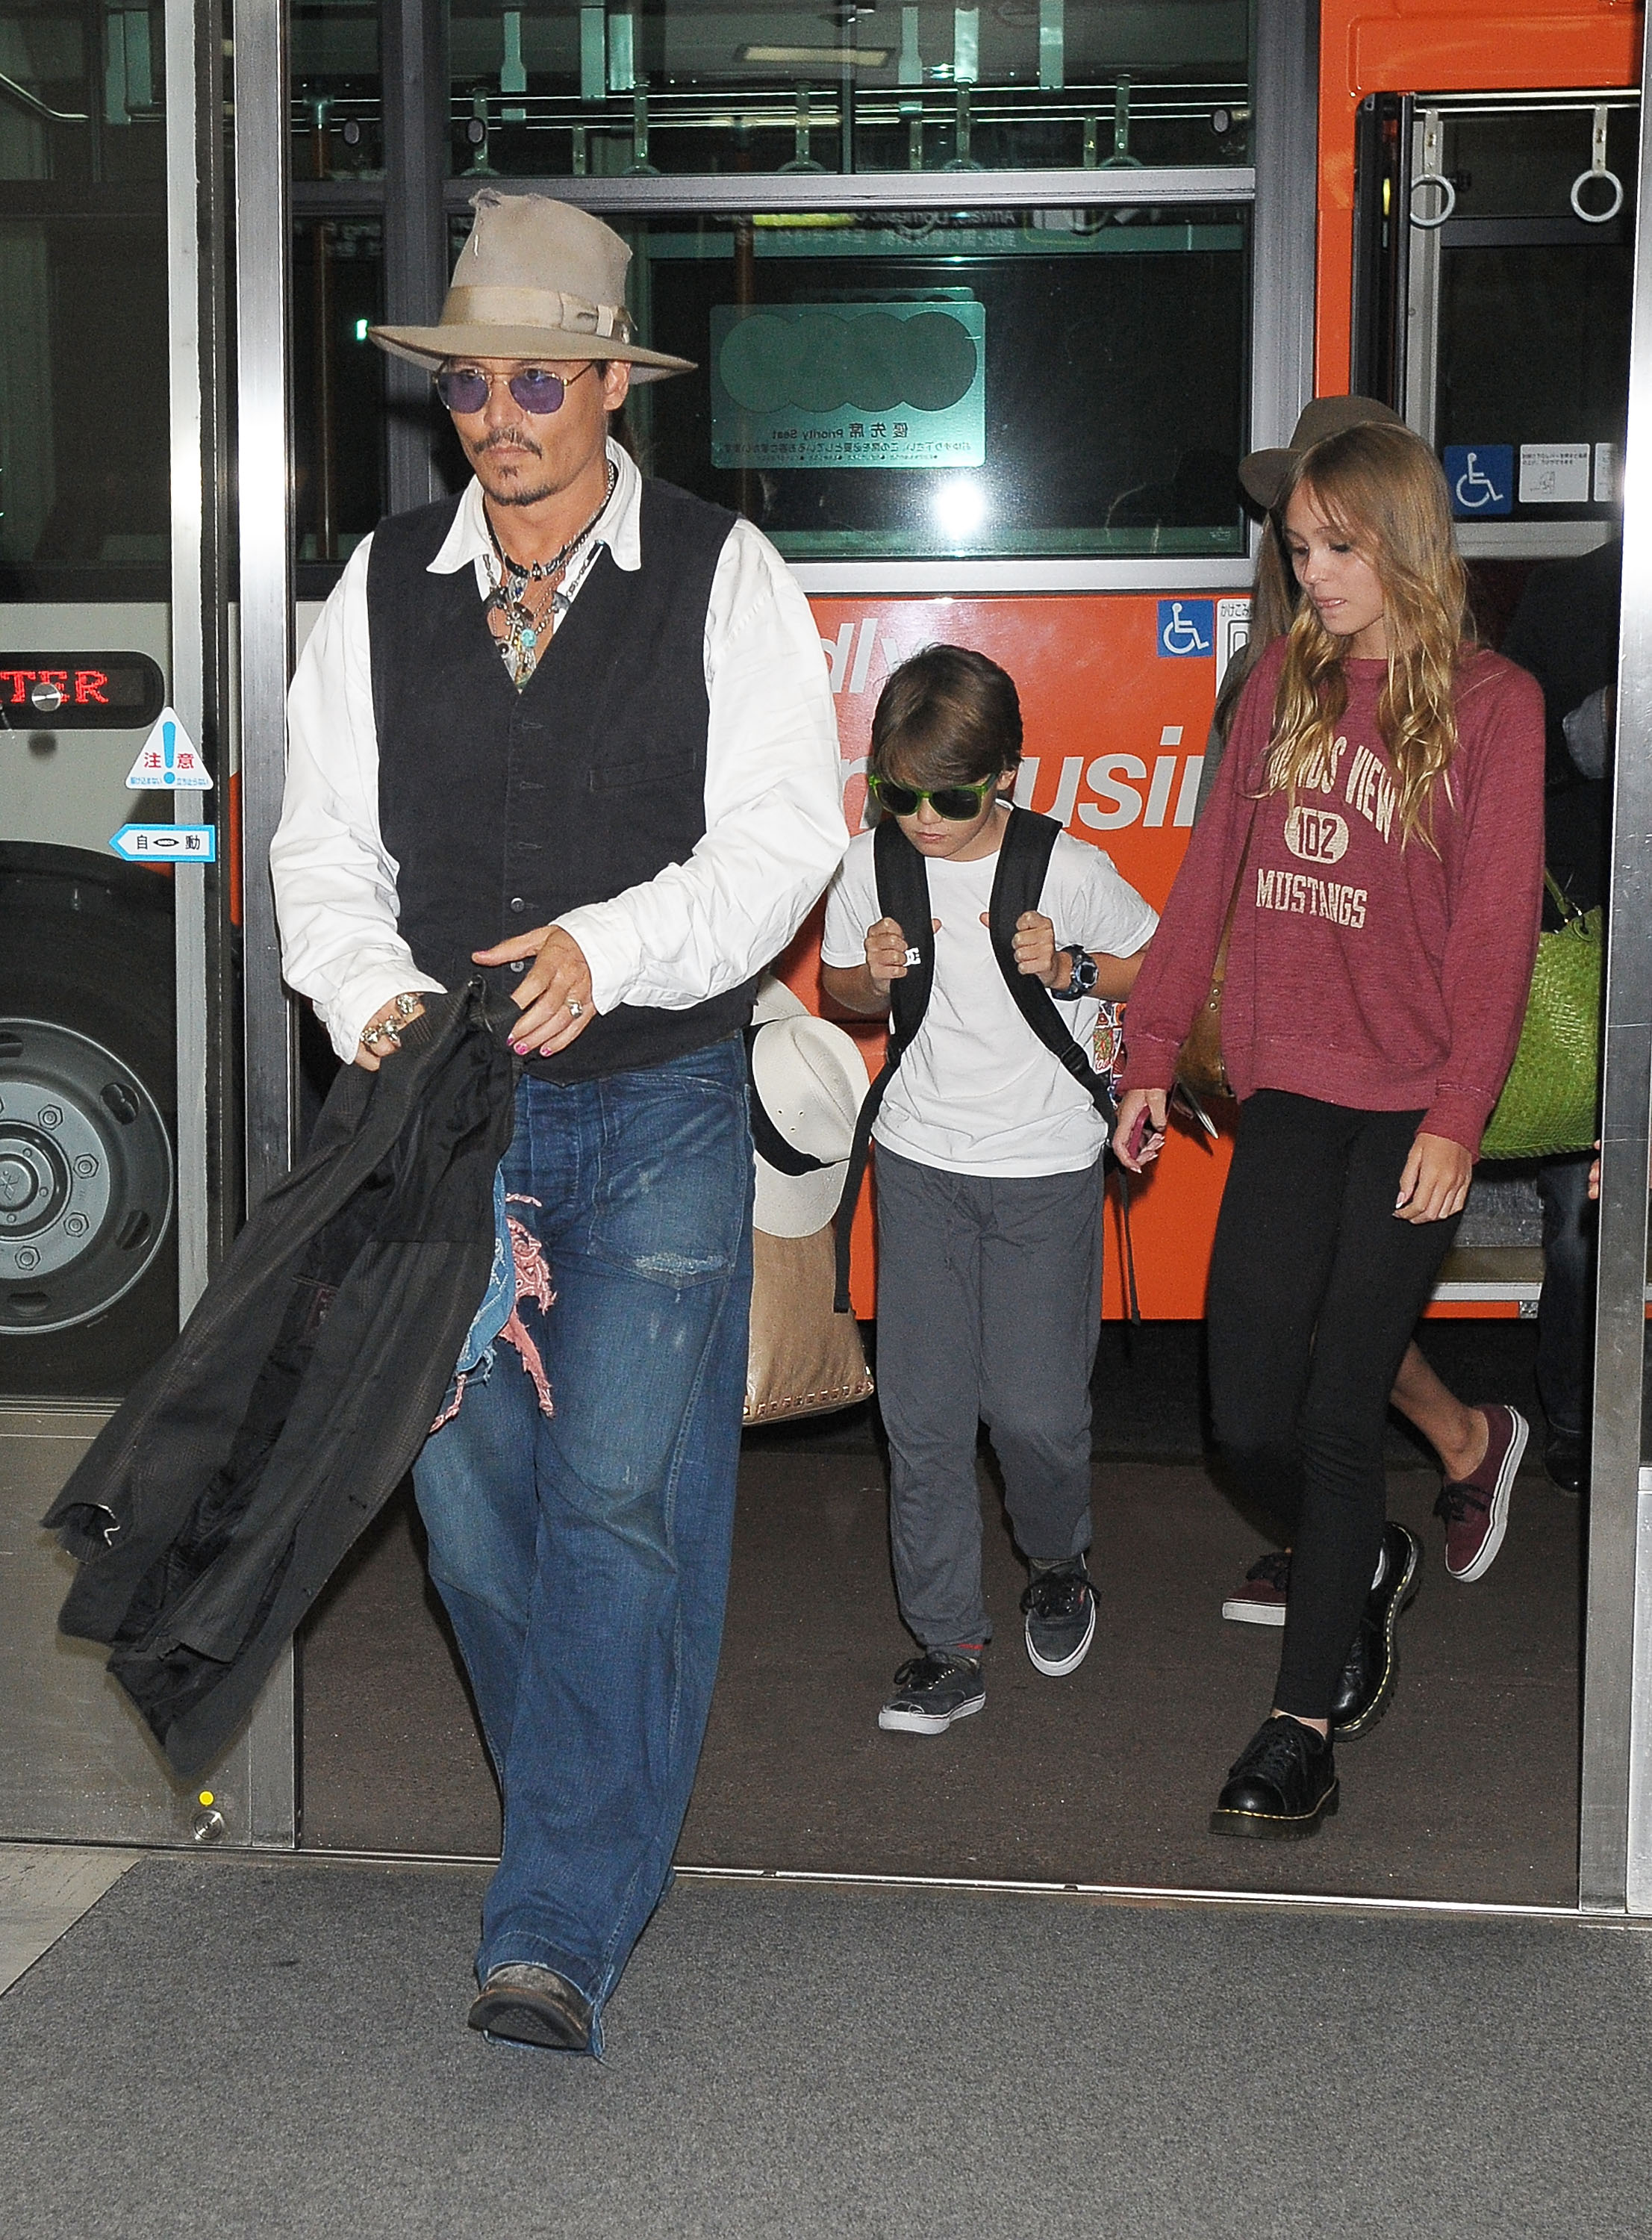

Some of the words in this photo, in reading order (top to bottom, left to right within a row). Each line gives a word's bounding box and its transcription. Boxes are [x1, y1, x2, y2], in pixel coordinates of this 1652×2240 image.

[1346, 745, 1396, 844] VIEW
[1298, 812, 1338, 859] 102
[1256, 868, 1368, 929] MUSTANGS
